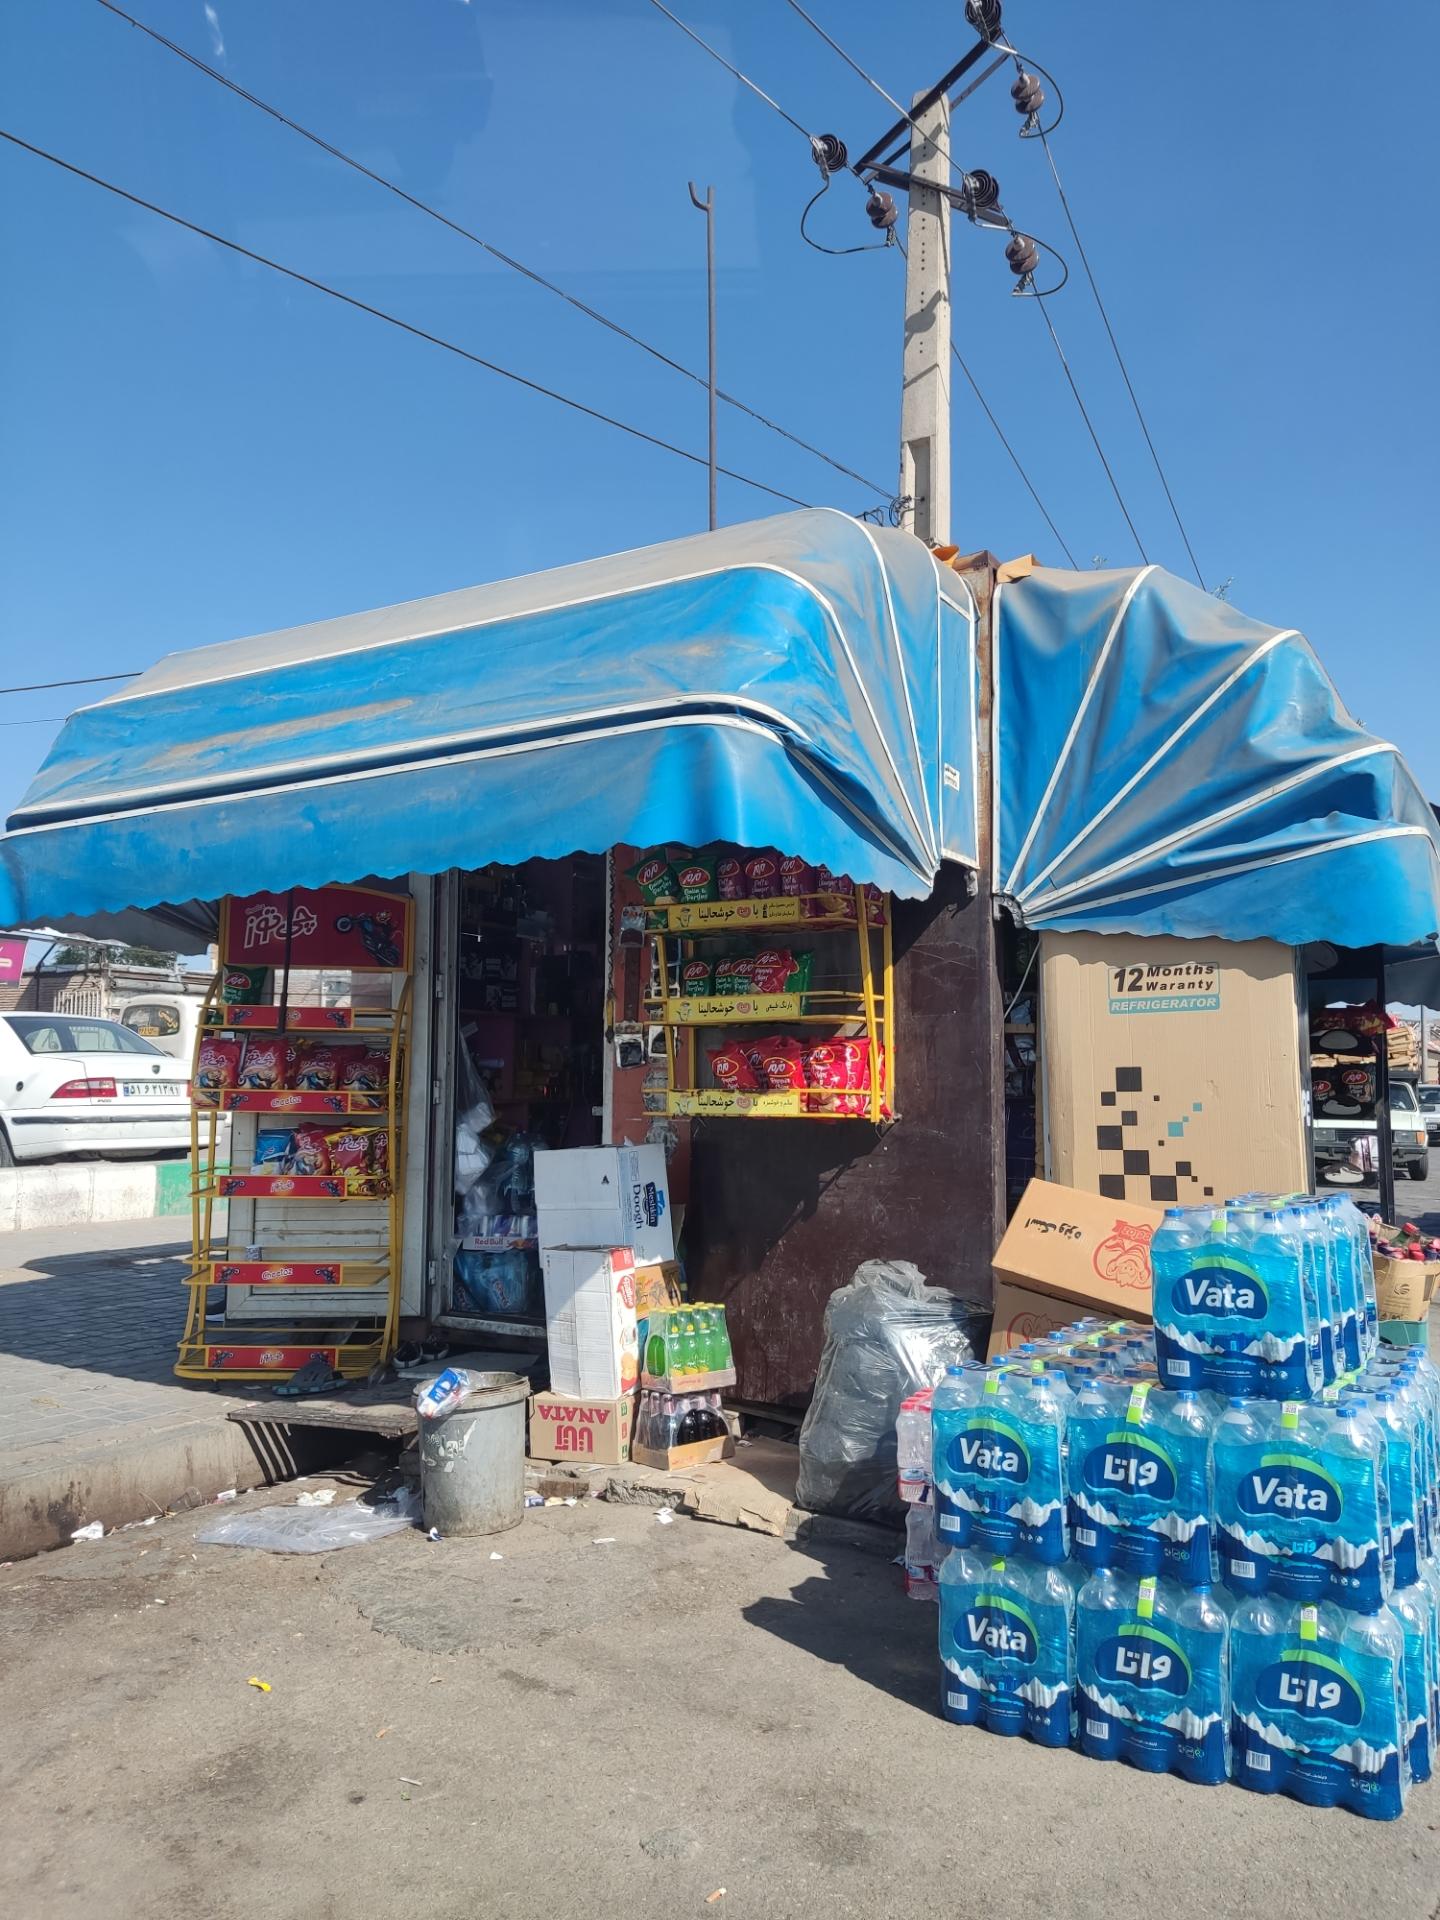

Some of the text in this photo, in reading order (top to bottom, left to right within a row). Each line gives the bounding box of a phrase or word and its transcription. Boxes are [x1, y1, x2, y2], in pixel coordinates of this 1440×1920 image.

[1114, 968, 1144, 993] 12
[1146, 964, 1214, 978] Months
[1146, 979, 1214, 991] Waranty
[1111, 997, 1217, 1011] REFRIGERATOR
[633, 1184, 644, 1230] Doogh
[474, 1238, 504, 1246] Red Bull
[1058, 1222, 1082, 1240] ویژه
[262, 1267, 294, 1281] Cheetoz
[1185, 1279, 1255, 1309] Vata
[537, 1405, 611, 1424] ANATA
[554, 1424, 593, 1453] آناتا
[960, 1438, 1019, 1473] Vata
[1103, 1454, 1158, 1487] واتا
[1252, 1476, 1328, 1511] Vata
[967, 1614, 1027, 1652] Vata
[1115, 1646, 1172, 1681] واتا
[1279, 1672, 1341, 1710] واتا
